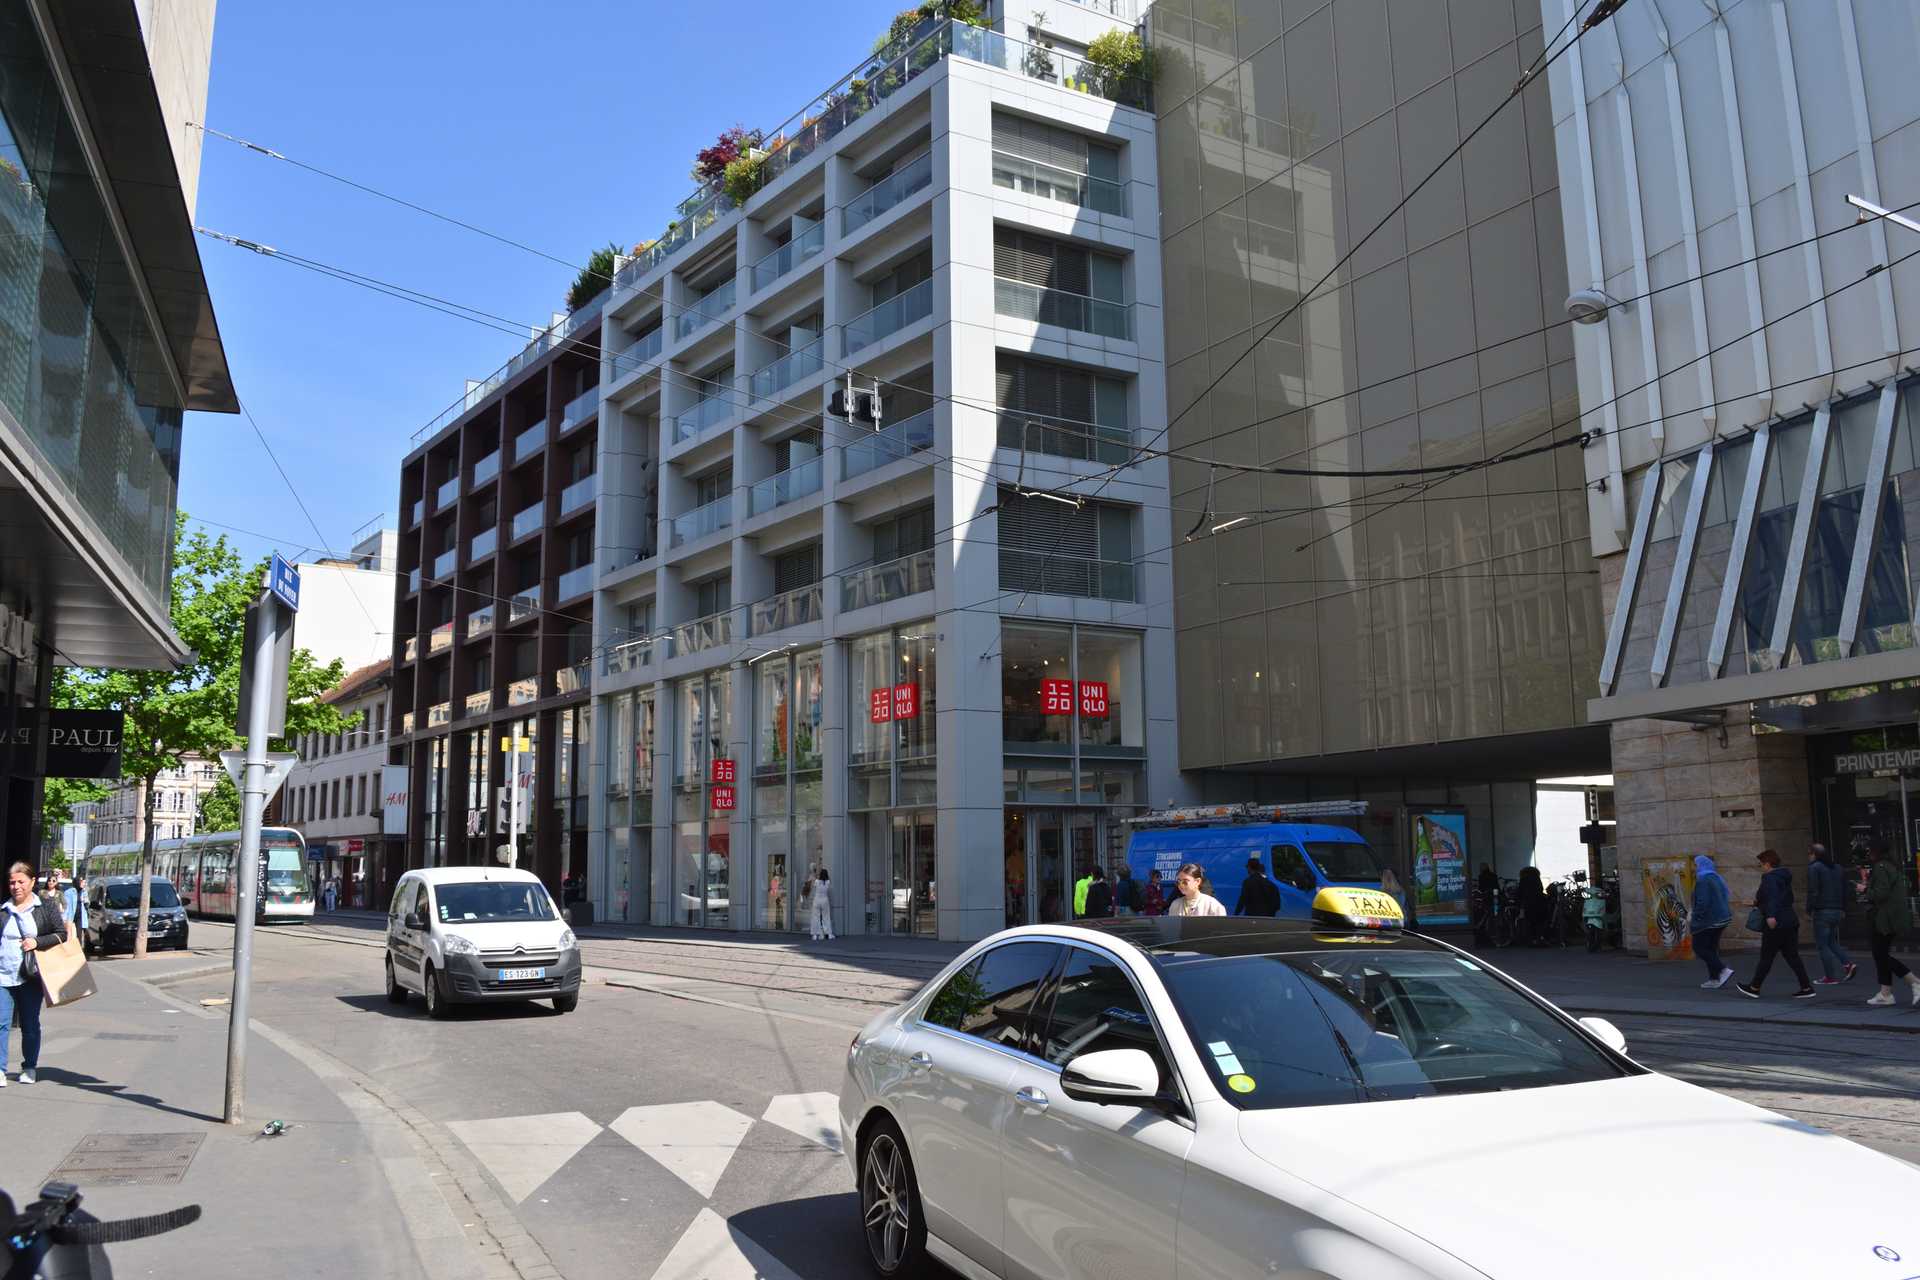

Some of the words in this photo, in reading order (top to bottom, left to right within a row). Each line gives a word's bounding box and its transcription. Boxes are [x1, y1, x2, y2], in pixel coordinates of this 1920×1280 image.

[896, 687, 911, 701] UNI
[1082, 685, 1103, 698] UNI
[896, 701, 913, 717] QLO
[1083, 699, 1105, 713] QLO
[49, 728, 119, 746] PAUL
[386, 792, 406, 806] H&M
[716, 788, 731, 798] UNI
[716, 798, 733, 808] QLO
[1348, 896, 1393, 912] TAXI
